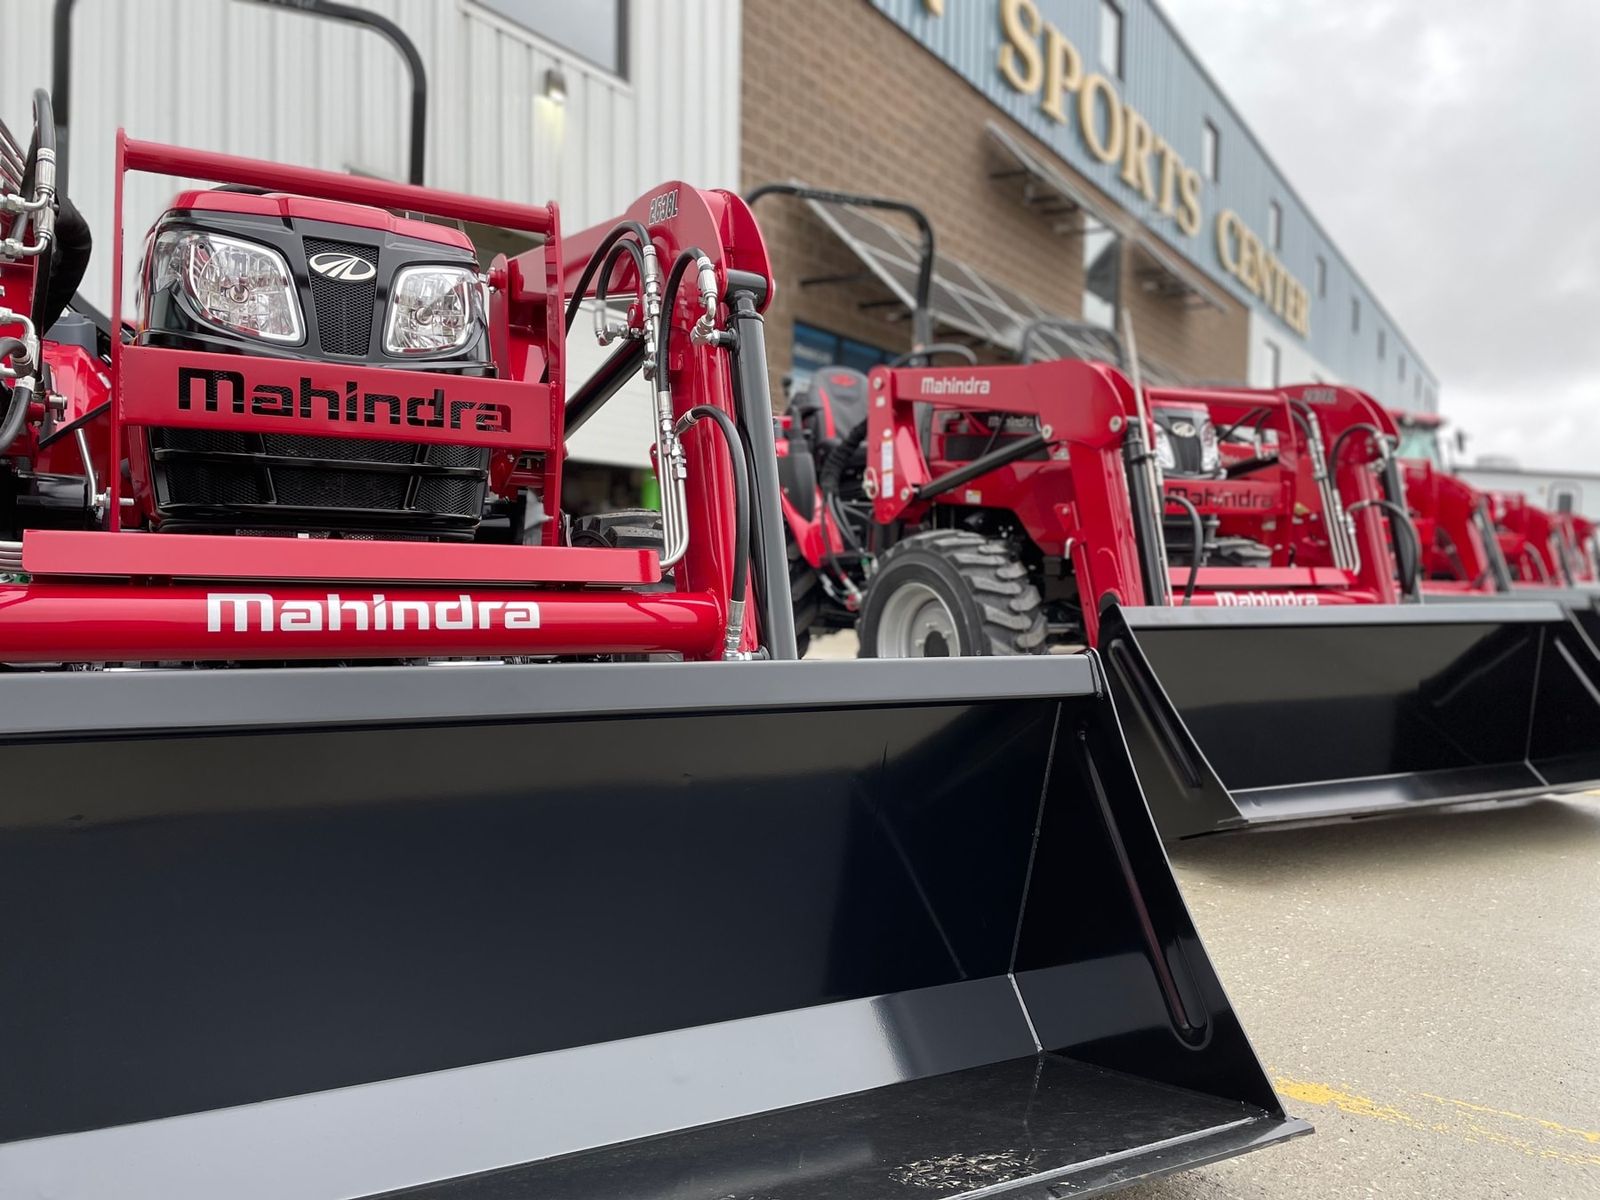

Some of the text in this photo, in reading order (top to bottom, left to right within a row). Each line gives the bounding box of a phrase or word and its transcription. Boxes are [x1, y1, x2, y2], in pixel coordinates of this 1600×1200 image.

[999, 0, 1312, 339] SPORTS CENTER
[178, 366, 512, 433] Mahindra
[921, 377, 990, 394] Mahindra
[207, 593, 541, 632] Mahindra
